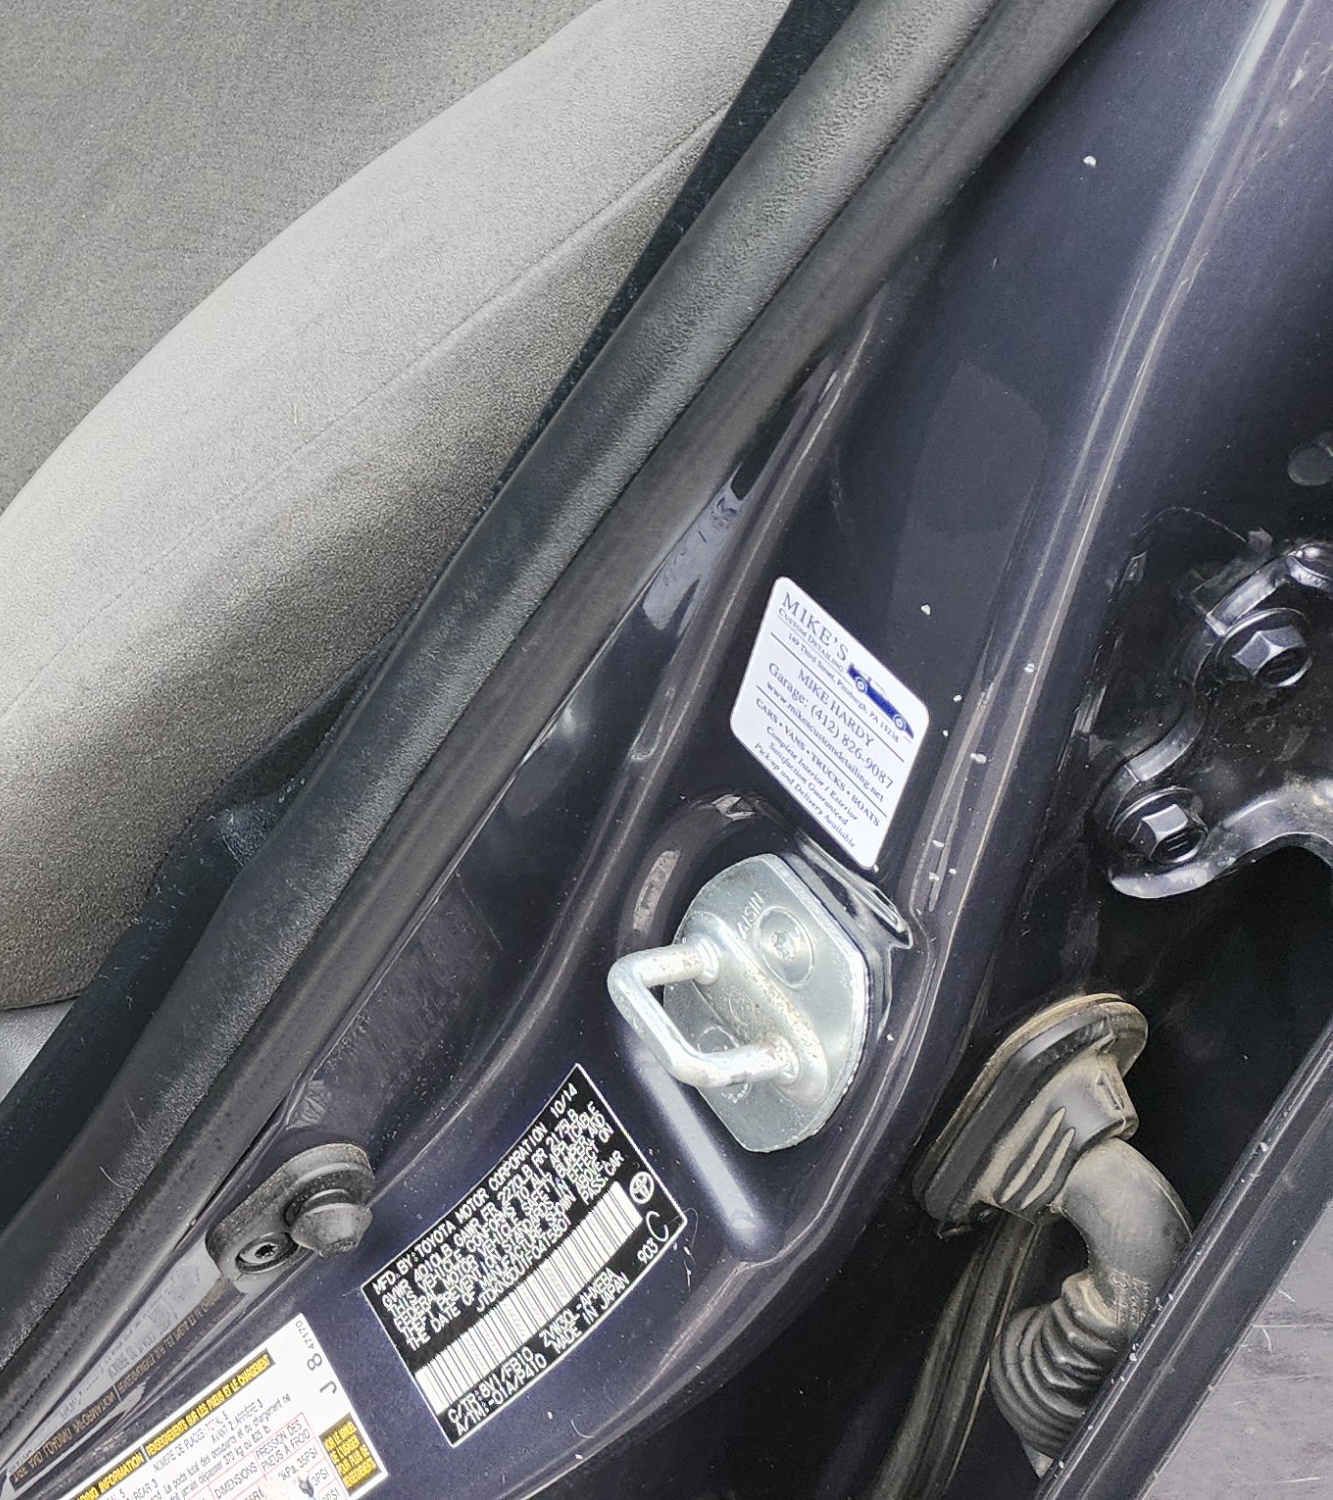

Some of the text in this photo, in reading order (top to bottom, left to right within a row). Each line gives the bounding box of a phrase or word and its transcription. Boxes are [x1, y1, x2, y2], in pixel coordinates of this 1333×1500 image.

[782, 590, 849, 663] MIKE'S
[765, 680, 884, 804] www.mikescustomdetailing.net
[766, 660, 893, 792] Garage: (412) 826-9087
[797, 668, 874, 749] MIKE HARDY
[869, 710, 879, 724] PA
[753, 740, 856, 850] Pick-up and Delivery Available
[755, 696, 880, 827] CARS VANS TRUCKS BOATS
[765, 724, 858, 823] Complete Interior Exterior
[768, 740, 848, 827] Satisfaction Guaranteed
[737, 891, 765, 940] AISIN
[454, 1185, 490, 1224] MOTOR
[486, 1120, 548, 1193] CORPORATION
[549, 1080, 578, 1119] 10/14
[380, 1107, 579, 1310] GVWR 4010LB GAWR FR 2270LB RR 2175LB
[388, 1099, 598, 1320] THIS VEHICLE CONFORMS TO ALL APPLICABLE
[400, 1121, 614, 1342] THEFT PREVENTION STANDARDS IN EFFECT ON
[635, 1206, 672, 1266] 903 C
[393, 1285, 442, 1330] FEDERAL
[441, 1253, 478, 1290] MOTOR
[477, 1212, 521, 1259] VEHICLE
[406, 1327, 431, 1353] THE
[430, 1301, 461, 1333] DATE
[460, 1287, 478, 1308] OF
[478, 1222, 546, 1291] MANUFACTURE
[543, 1188, 577, 1227] SHOWN
[294, 1318, 315, 1351] 47170
[551, 1320, 582, 1355] MADE
[581, 1304, 599, 1326] IN
[596, 1270, 630, 1311] JAPAN
[195, 1401, 209, 1418] LES
[221, 1383, 232, 1398] ET
[229, 1377, 240, 1392] LE
[305, 1351, 324, 1372] 8
[97, 1450, 145, 1494] INFORMATION
[198, 1452, 210, 1467] des
[213, 1459, 258, 1500] DIMENSIONS
[254, 1417, 303, 1462] PRESSION DES
[260, 1447, 284, 1473] PNEUS
[289, 1427, 311, 1450] FROID
[295, 1444, 319, 1469] 35PSI
